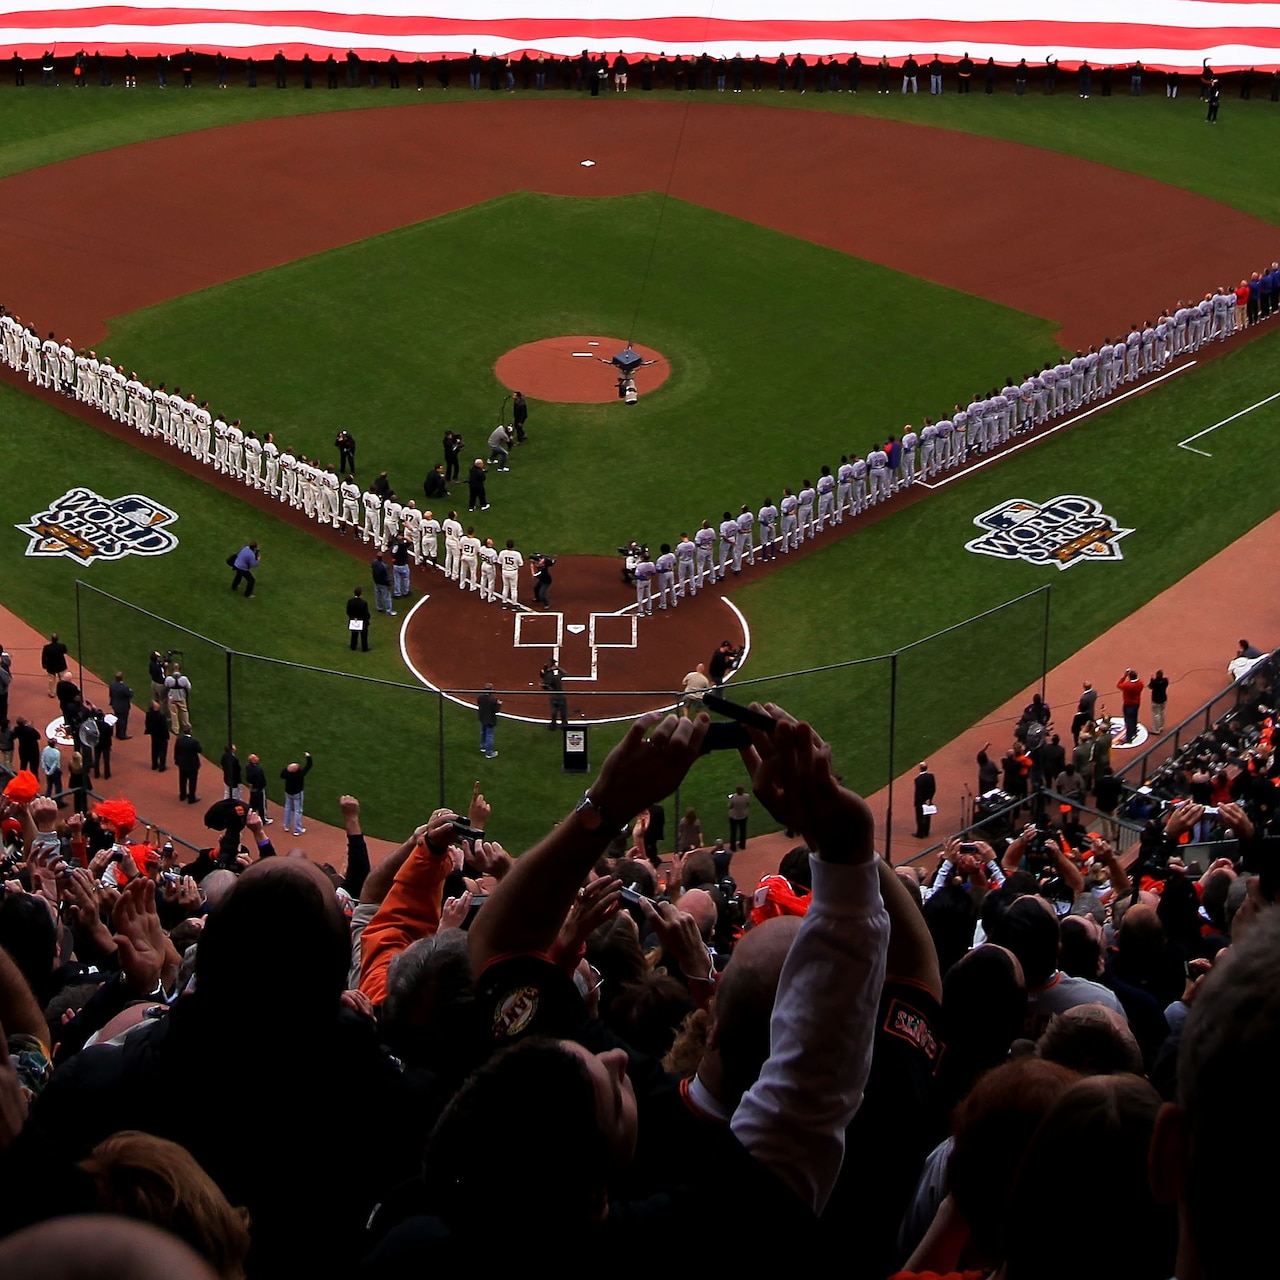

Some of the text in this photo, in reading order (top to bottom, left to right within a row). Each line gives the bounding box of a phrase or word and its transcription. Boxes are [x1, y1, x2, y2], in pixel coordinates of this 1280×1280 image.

[42, 509, 126, 556] SERIES
[55, 490, 169, 551] WORLD
[975, 499, 1090, 554] WORLD
[1017, 516, 1107, 560] SERIES
